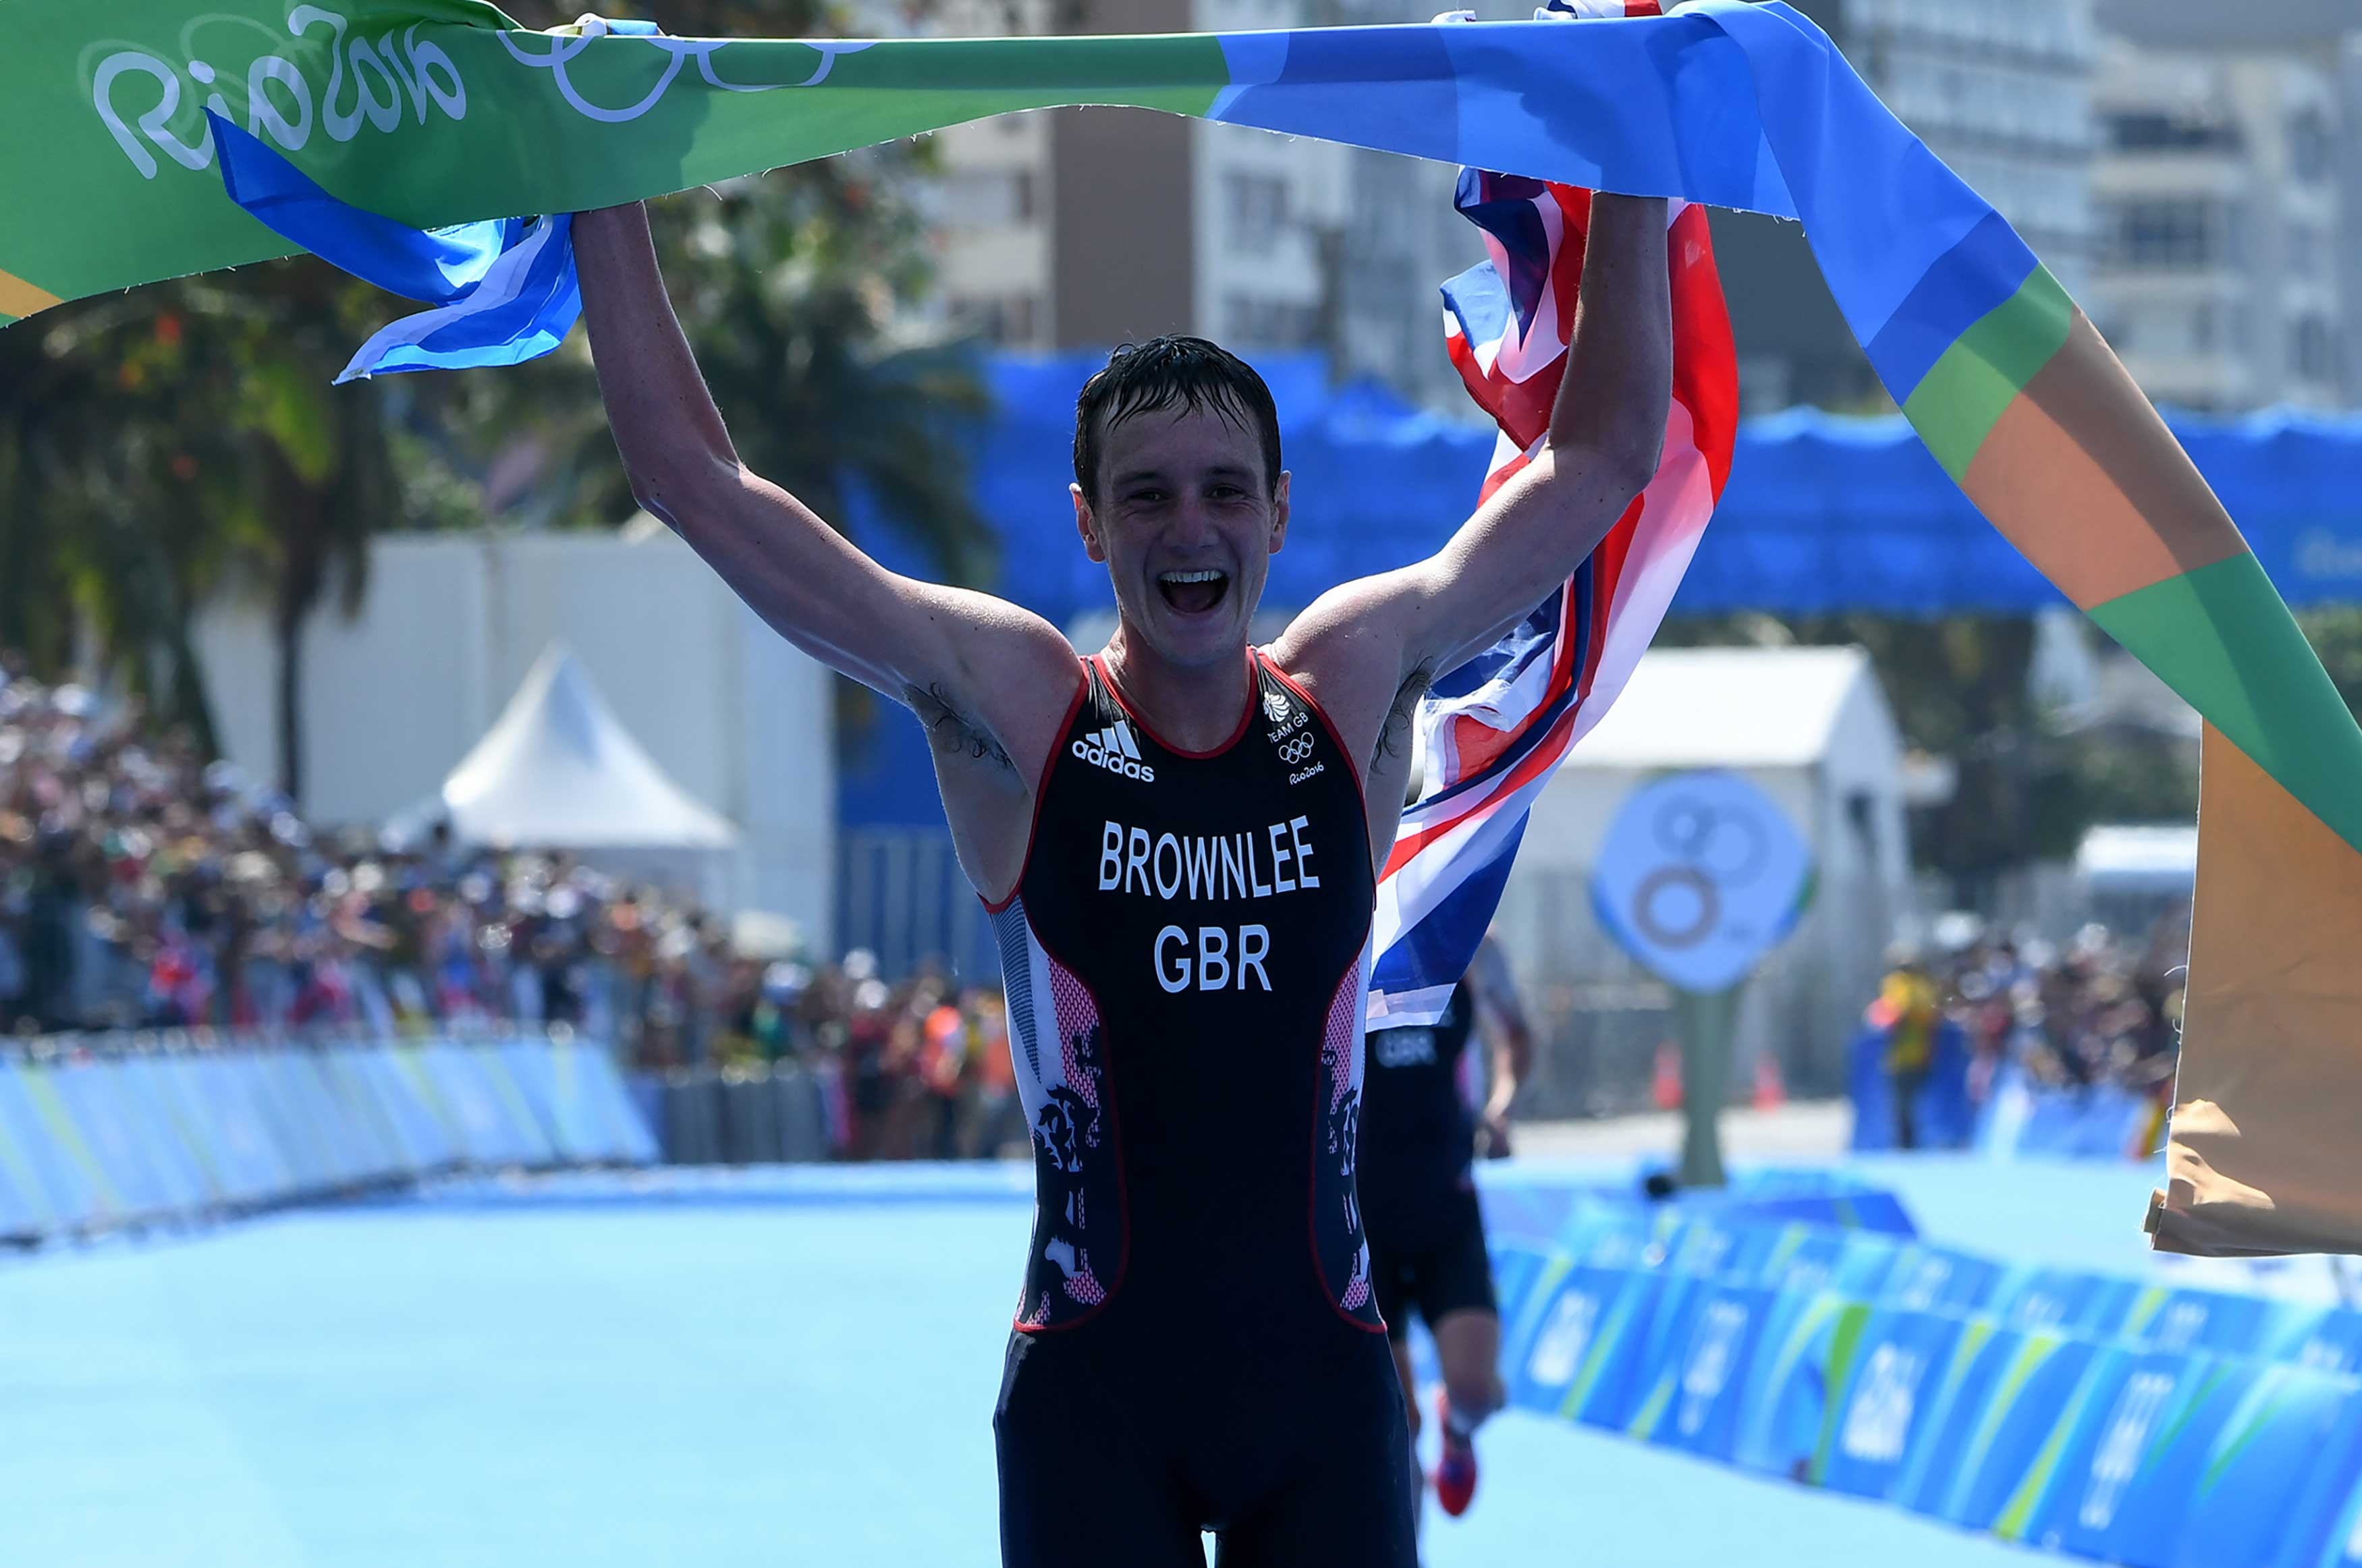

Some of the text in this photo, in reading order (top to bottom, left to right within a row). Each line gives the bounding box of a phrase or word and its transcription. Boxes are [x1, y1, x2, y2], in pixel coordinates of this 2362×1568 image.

[1267, 712, 1309, 744] TEAM GB
[1072, 739, 1155, 783] adidas
[1099, 814, 1320, 900] BROWNLEE
[1154, 924, 1272, 992] GBR
